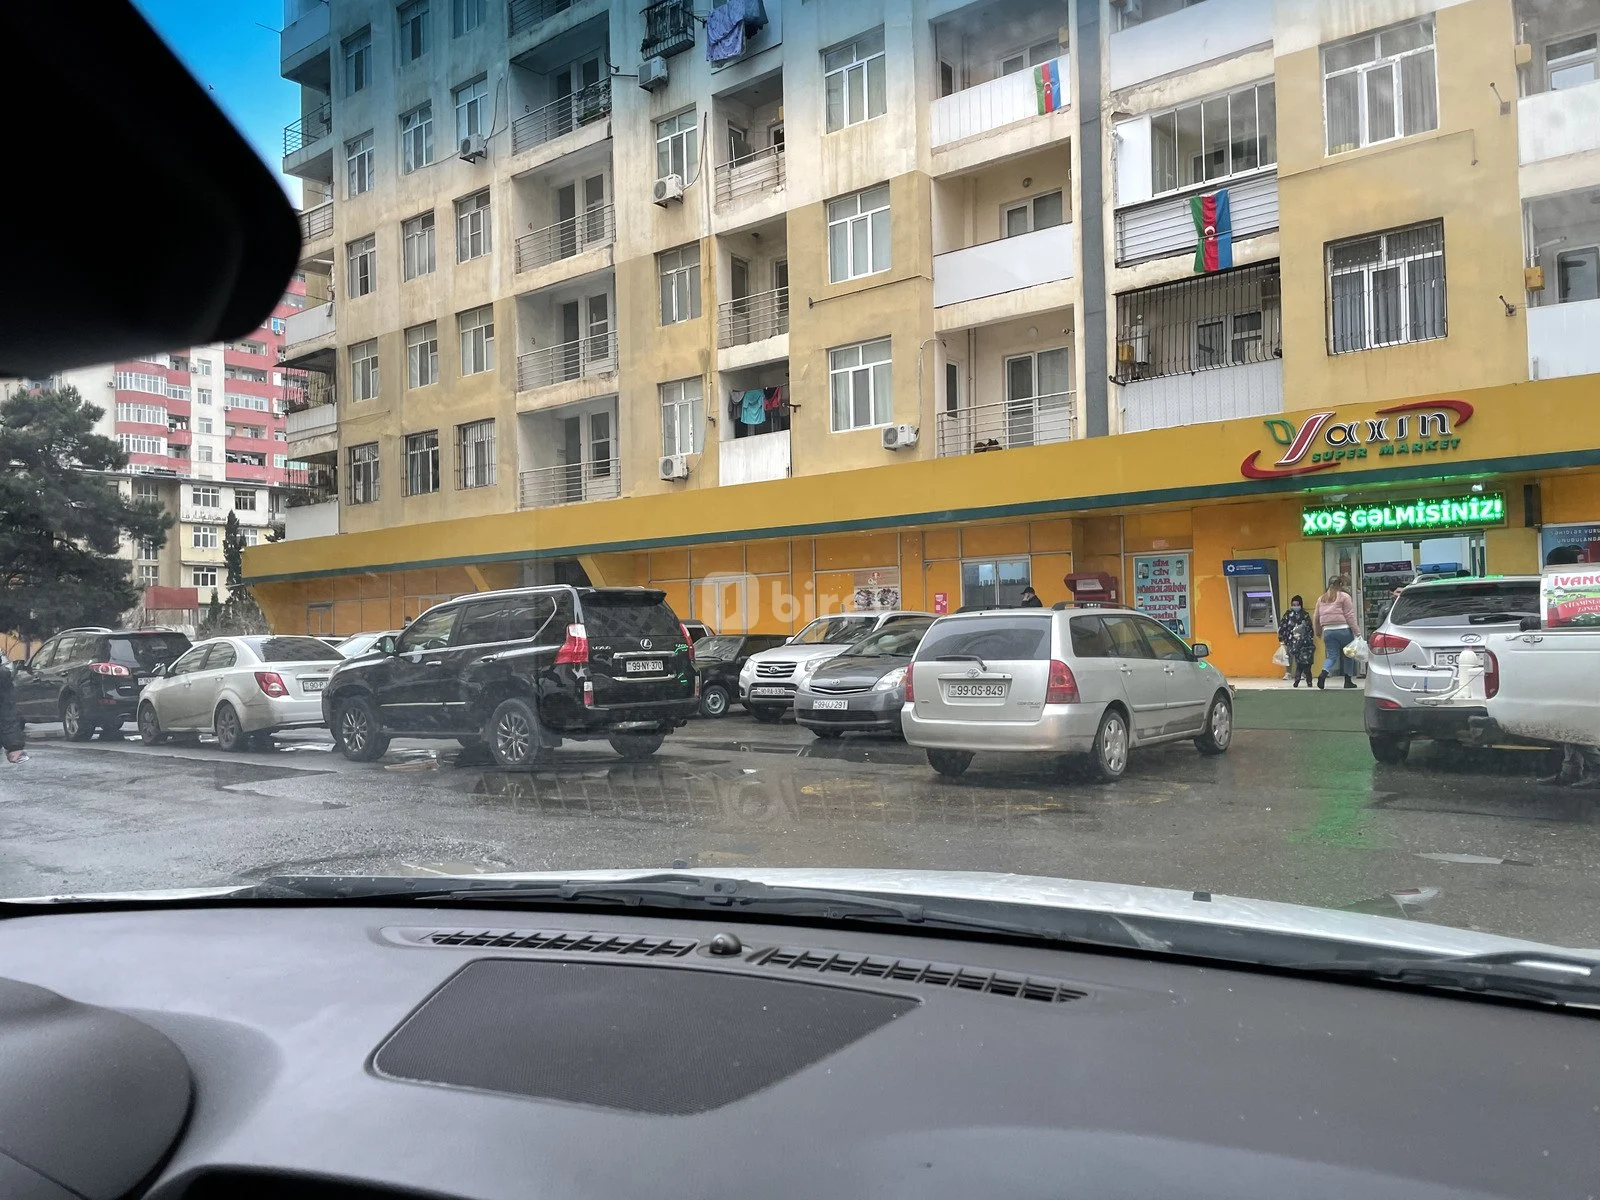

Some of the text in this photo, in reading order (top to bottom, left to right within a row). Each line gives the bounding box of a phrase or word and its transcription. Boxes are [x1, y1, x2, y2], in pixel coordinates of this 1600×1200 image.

[1312, 438, 1462, 462] SUPER MARKET
[1302, 497, 1504, 534] XOŞ GƏLMİSİNİZ!
